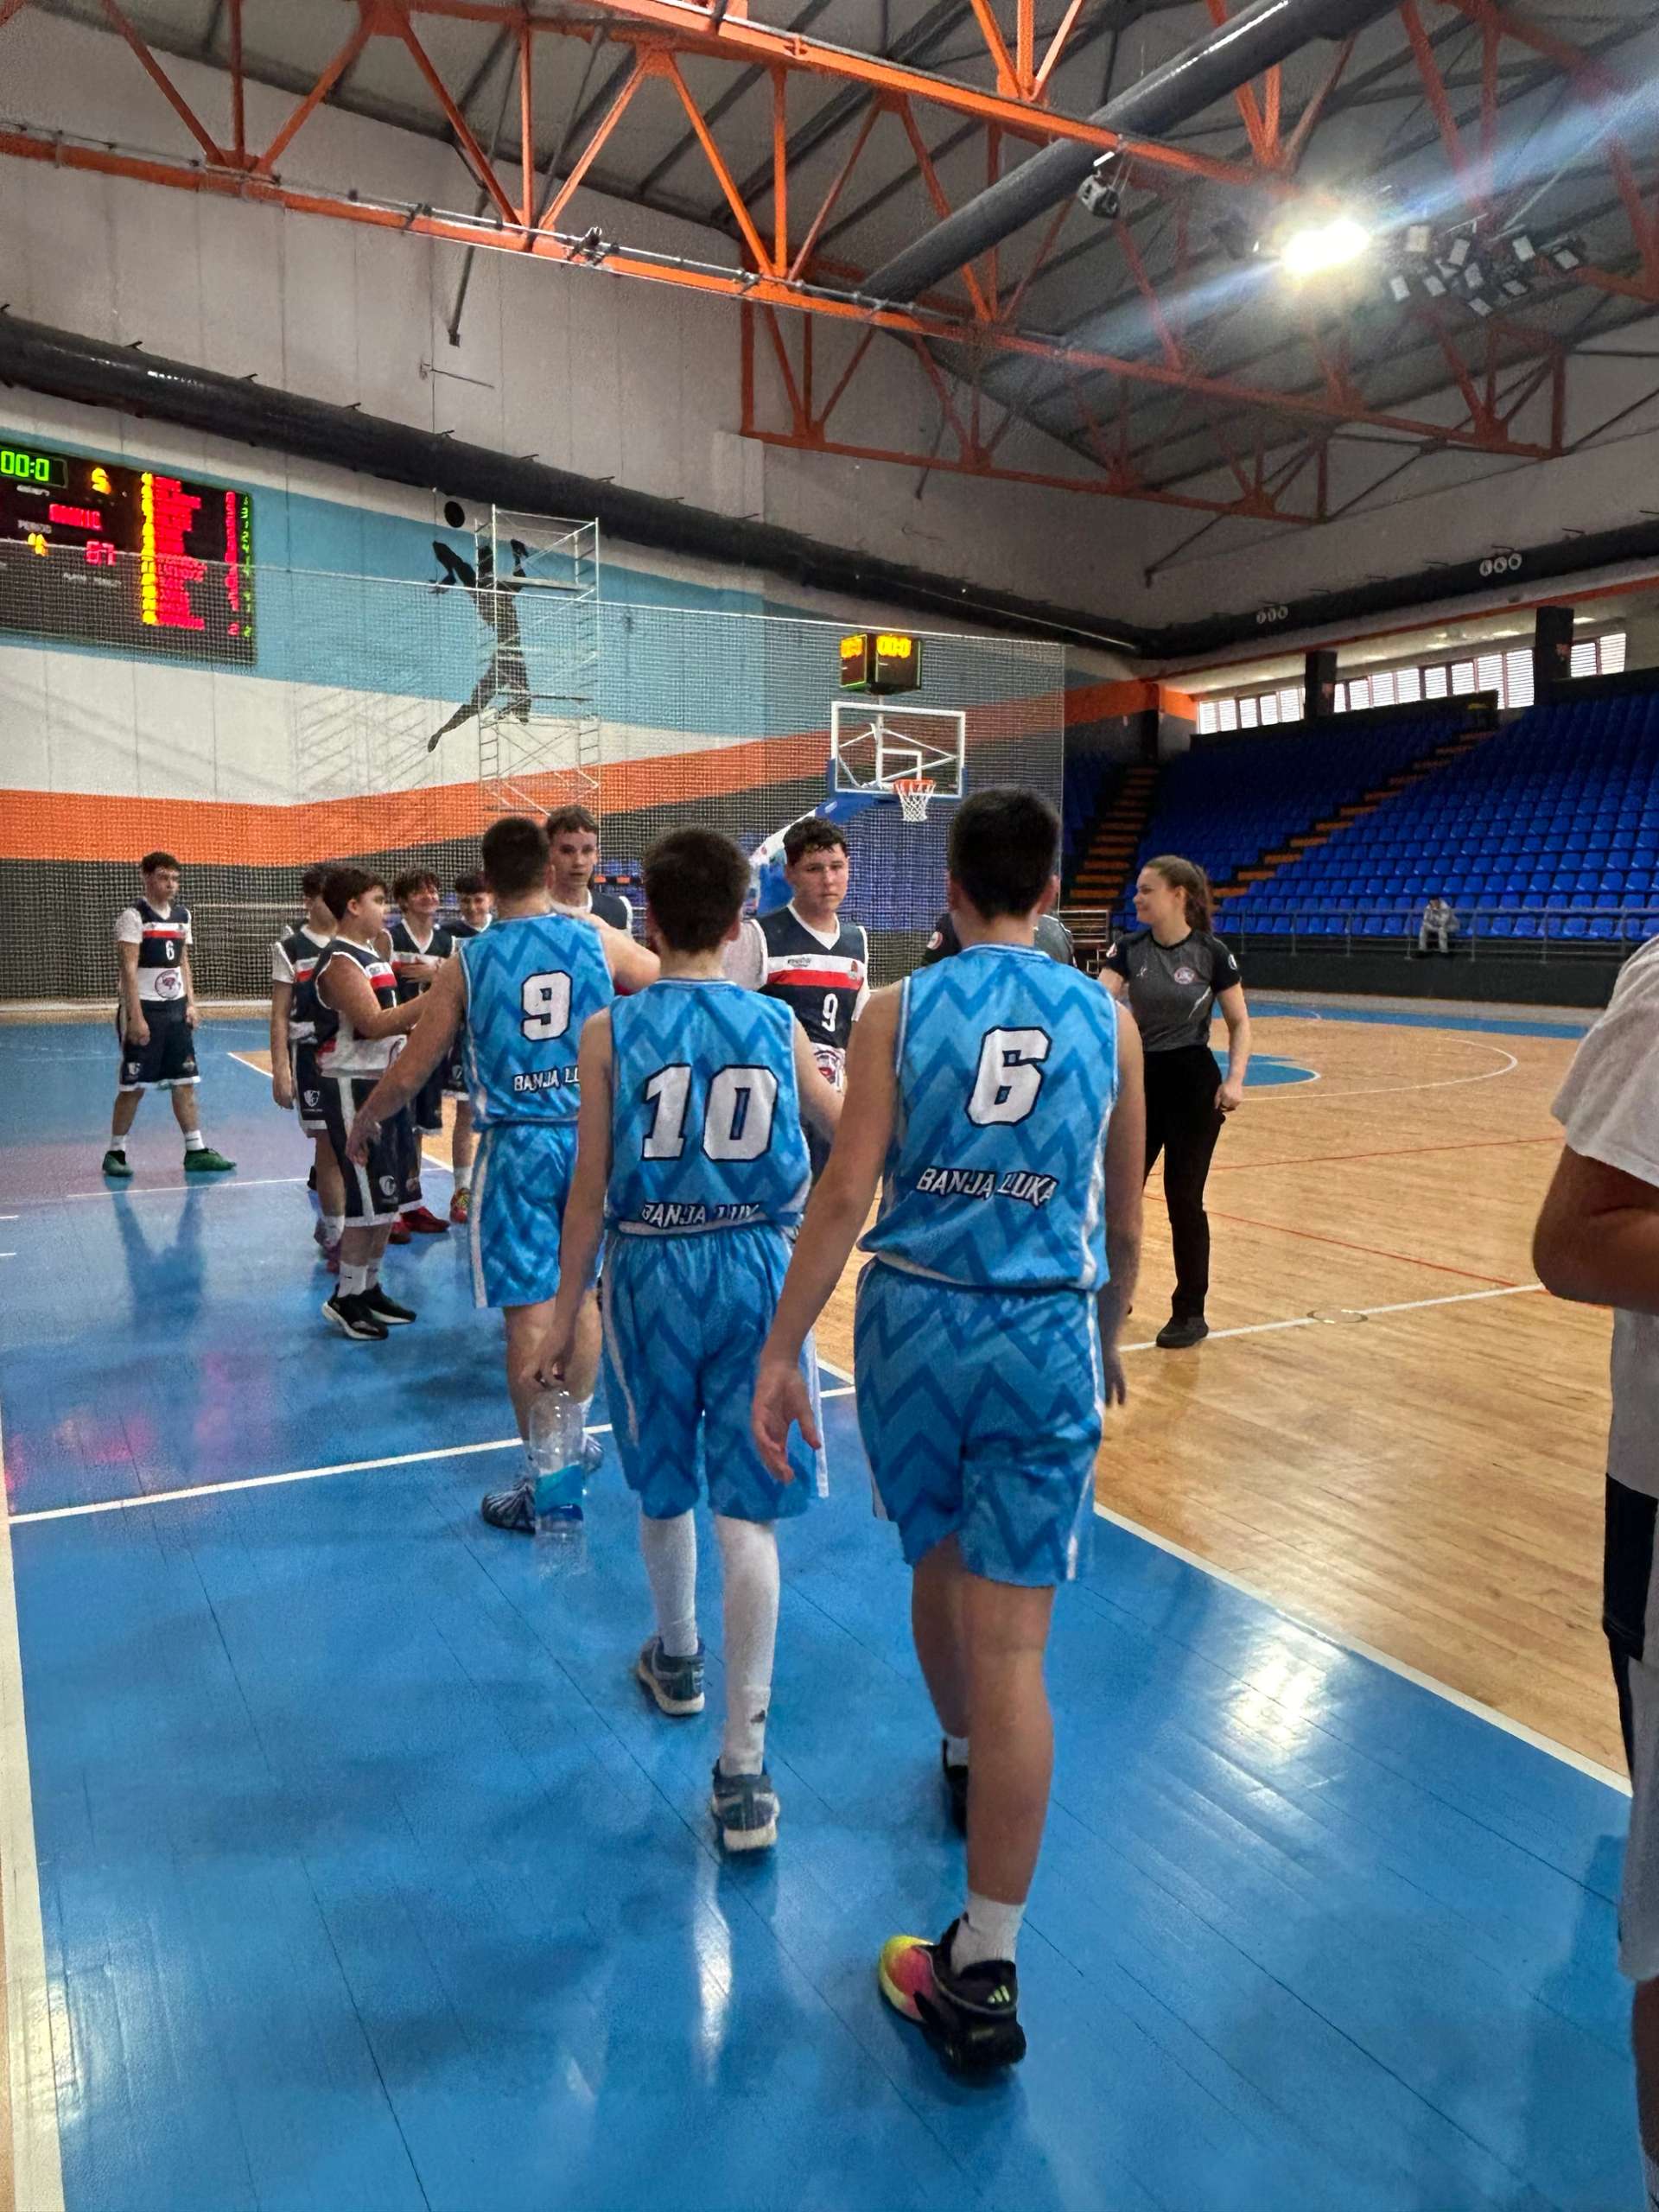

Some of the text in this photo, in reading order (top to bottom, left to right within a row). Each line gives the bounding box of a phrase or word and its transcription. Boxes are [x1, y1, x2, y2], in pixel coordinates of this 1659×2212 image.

[165, 940, 175, 960] 6
[521, 969, 573, 1042] 9
[822, 993, 838, 1032] 9
[513, 1068, 560, 1091] BANJA
[964, 1026, 1052, 1128] 6
[641, 1063, 778, 1162] 10
[916, 1166, 1058, 1207] BANJA LUKA
